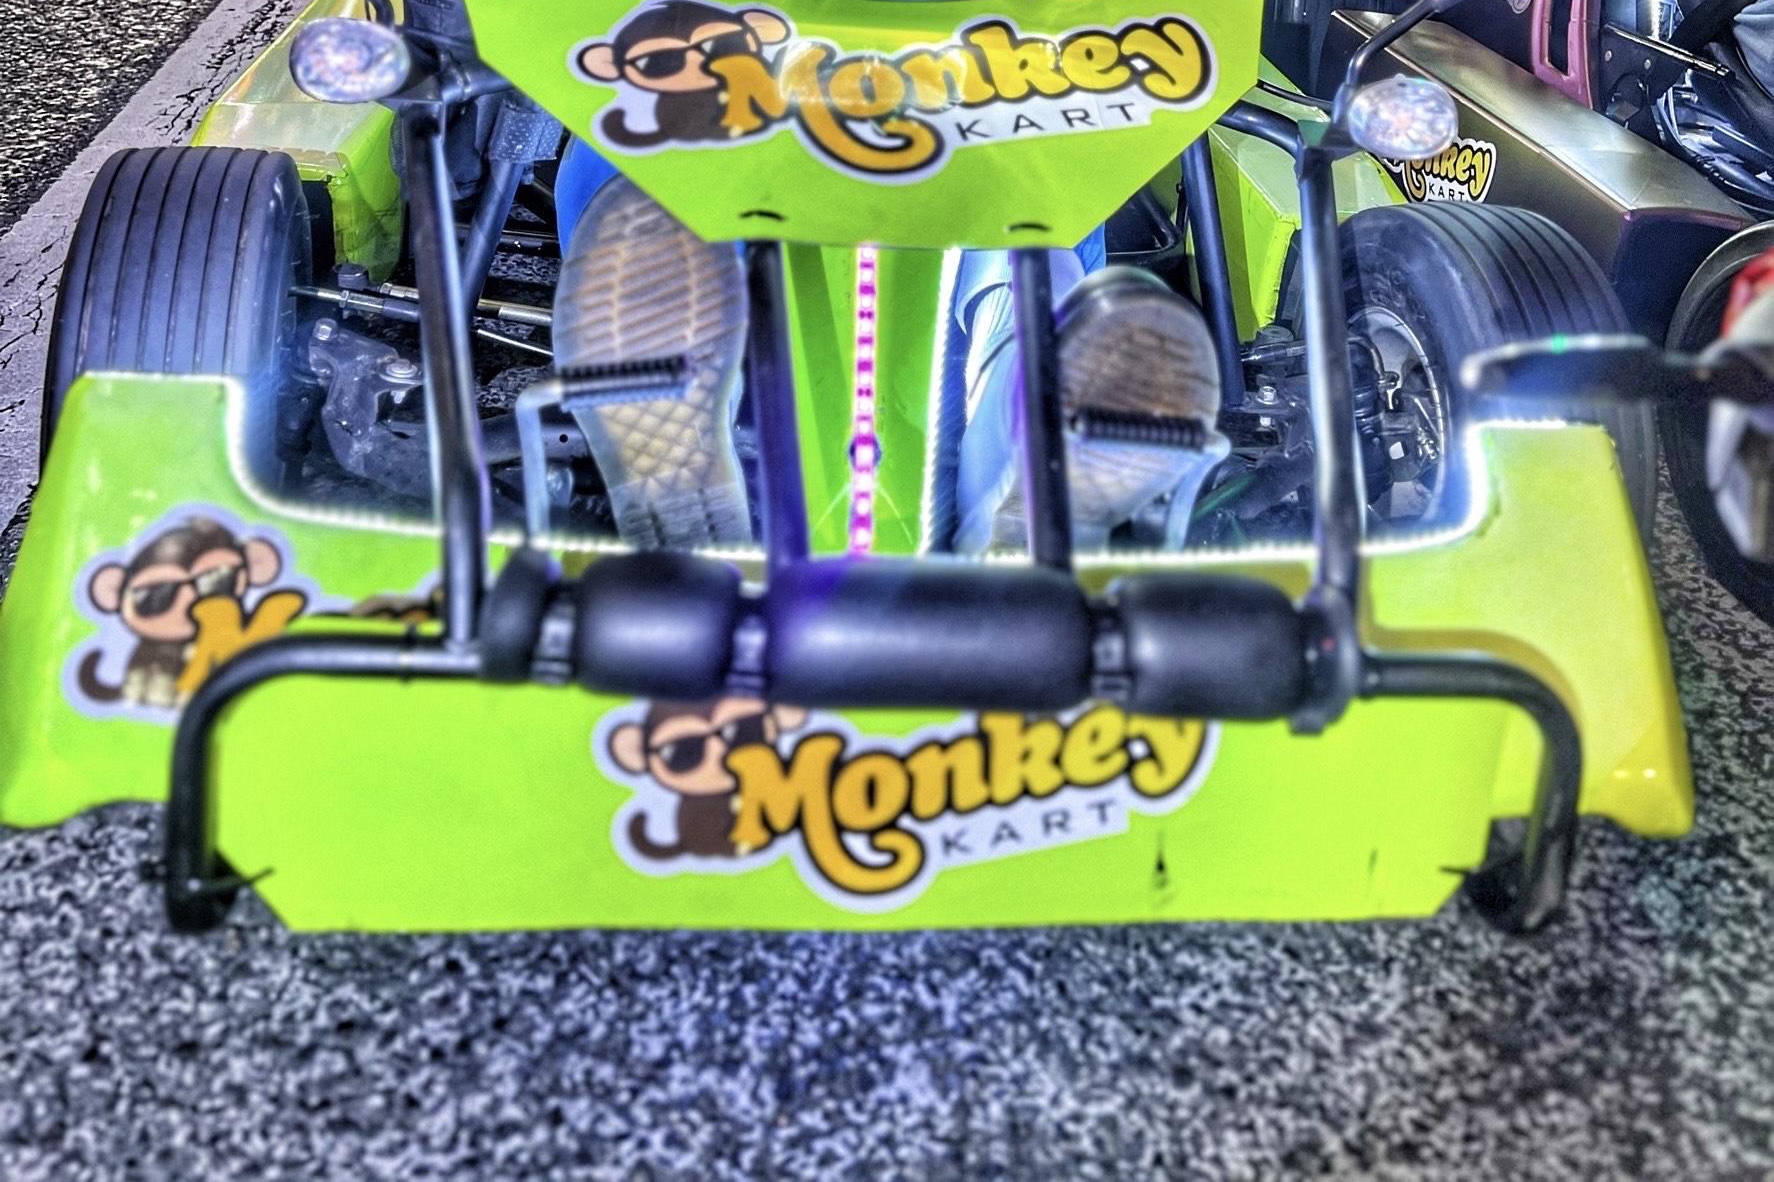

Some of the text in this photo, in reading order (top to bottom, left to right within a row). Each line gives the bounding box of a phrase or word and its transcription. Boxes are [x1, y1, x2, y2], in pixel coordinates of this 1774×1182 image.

[707, 15, 1212, 175] Monkey
[955, 101, 1137, 143] KART
[1429, 182, 1465, 202] KART
[724, 703, 1208, 896] Monkey
[940, 797, 1120, 856] KART
